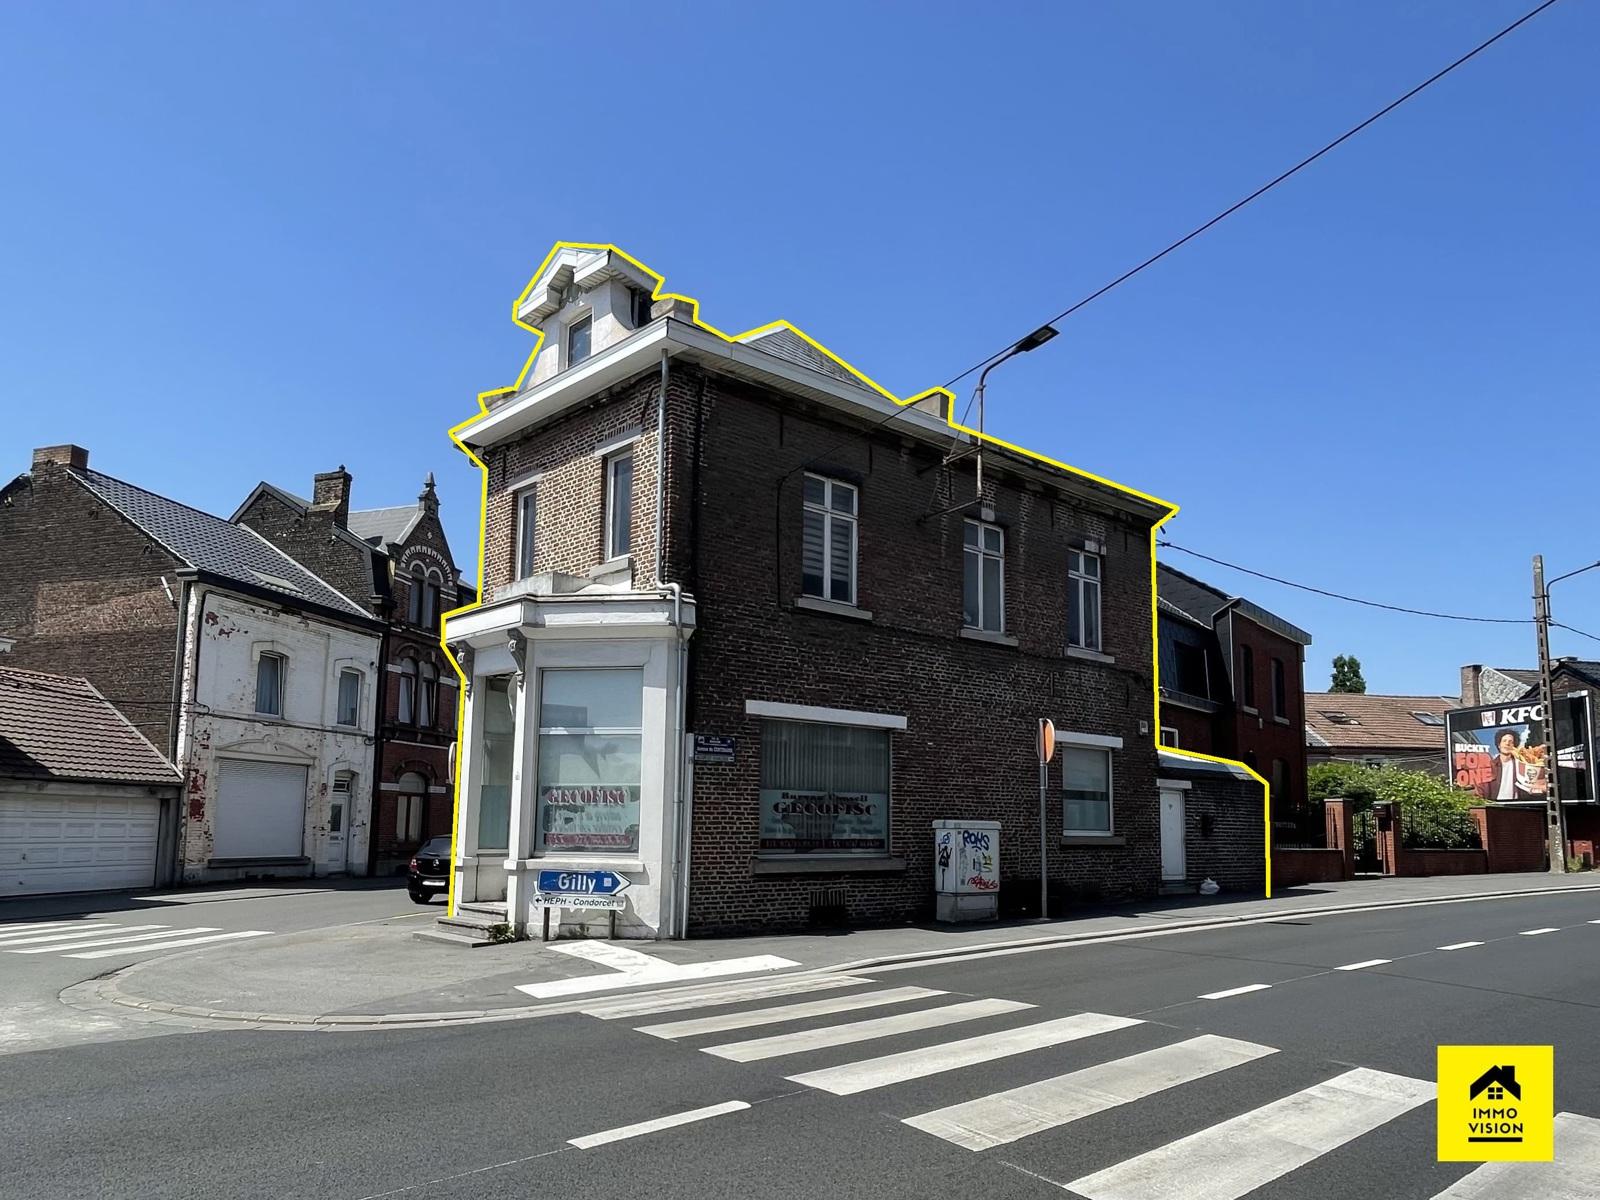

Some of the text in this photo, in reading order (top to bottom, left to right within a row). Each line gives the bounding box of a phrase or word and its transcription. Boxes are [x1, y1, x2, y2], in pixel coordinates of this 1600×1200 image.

[1499, 704, 1544, 725] KFC
[1454, 743, 1490, 753] BUCKET
[1455, 752, 1493, 770] FOR
[1456, 767, 1493, 788] ONE
[773, 801, 878, 816] GECOFISC
[558, 873, 596, 894] Gilly
[543, 896, 567, 905] HEPH
[573, 898, 615, 907] Condorcet
